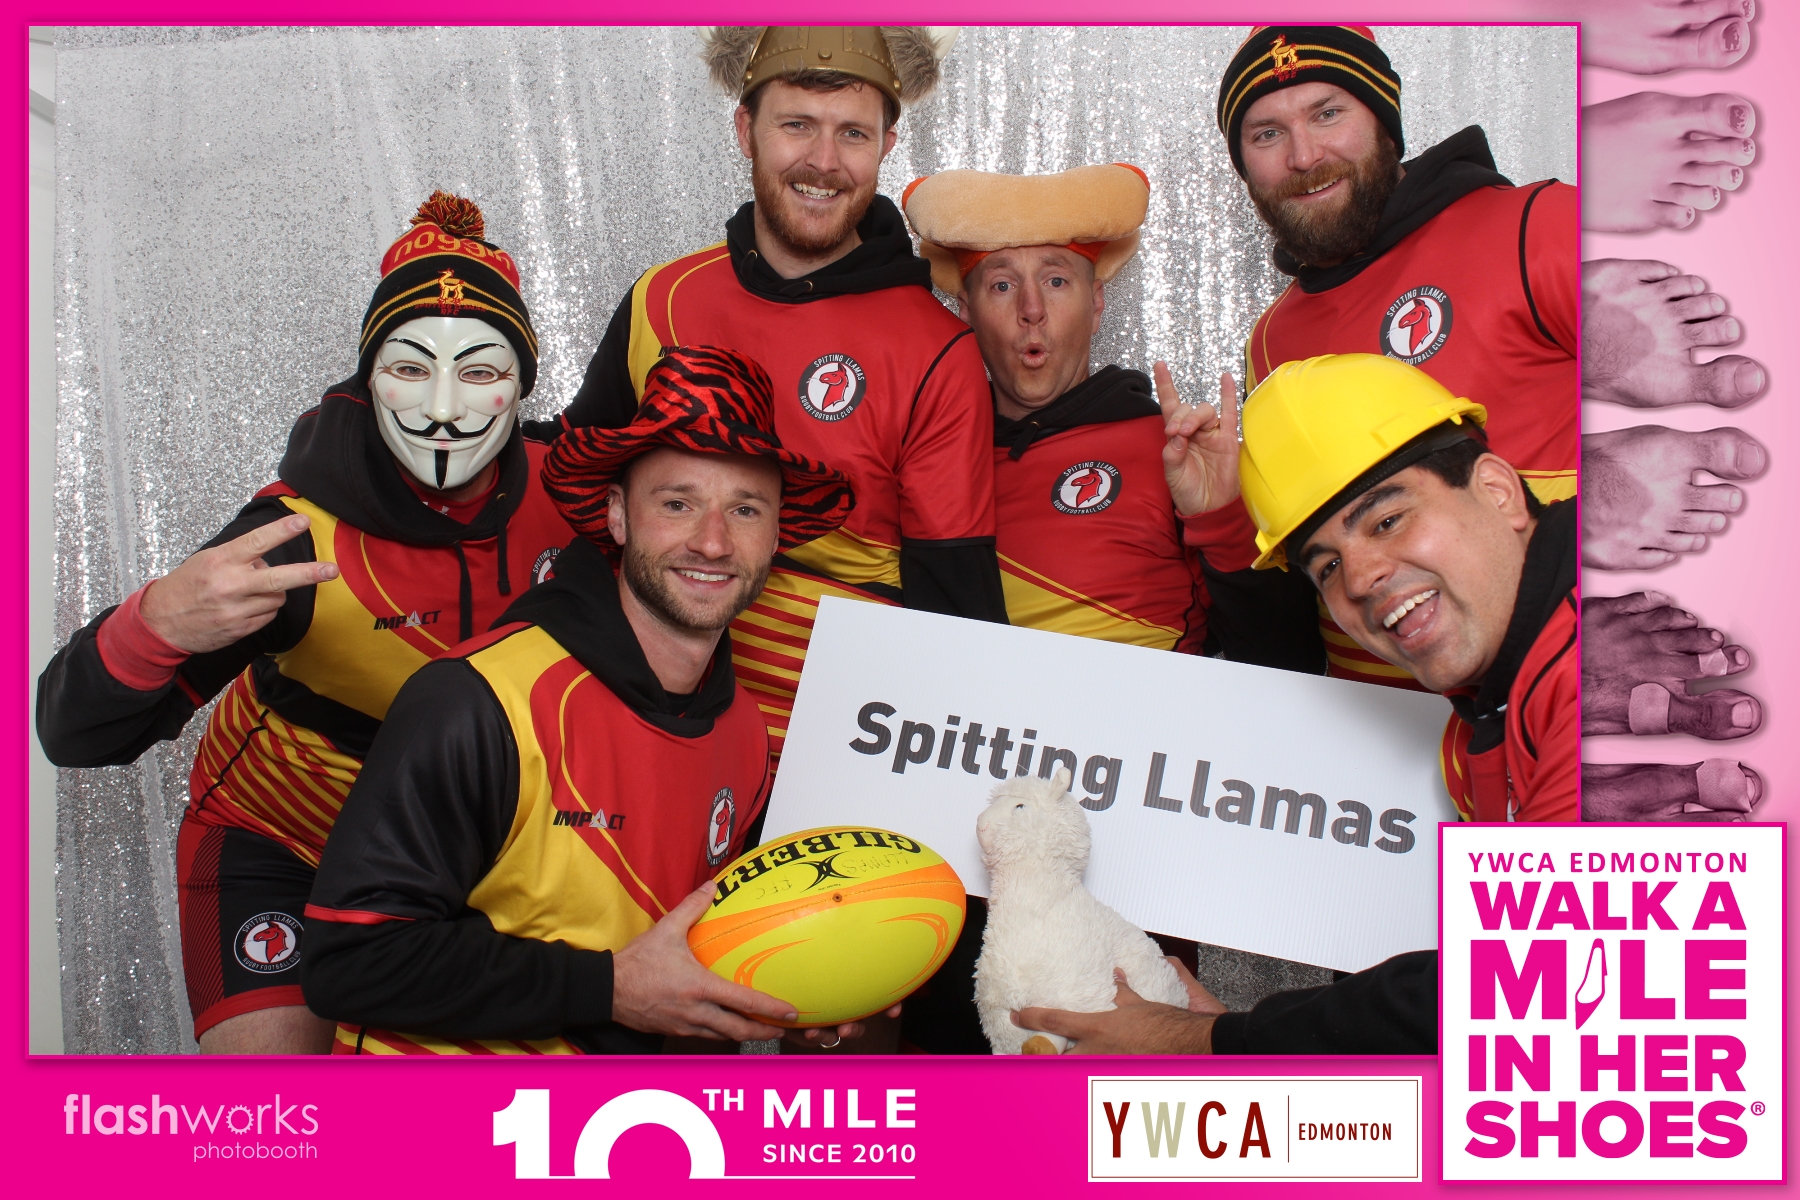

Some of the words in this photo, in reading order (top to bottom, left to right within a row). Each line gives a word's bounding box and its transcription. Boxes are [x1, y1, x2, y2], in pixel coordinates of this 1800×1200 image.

[1387, 289, 1417, 317] SPITTING
[1420, 286, 1447, 303] LLAMAS
[1432, 333, 1447, 351] CLUB
[813, 354, 844, 368] SPITTING
[845, 357, 865, 381] LLAMAS
[811, 409, 841, 421] FOOTBALL
[840, 405, 854, 418] CLUB
[1063, 461, 1094, 477] SPITTING
[1096, 462, 1119, 477] LLAMAS
[1096, 498, 1112, 511] CLUB
[532, 549, 551, 574] SPITTING
[373, 610, 442, 630] IMPACT
[848, 701, 1123, 812] Spitting
[1142, 751, 1418, 854] Llamas
[553, 808, 626, 830] IMPACT
[713, 831, 921, 908] GILBERT
[242, 914, 270, 933] SPITTING
[273, 914, 299, 929] LLAMAS
[260, 960, 291, 971] FOOTBALL
